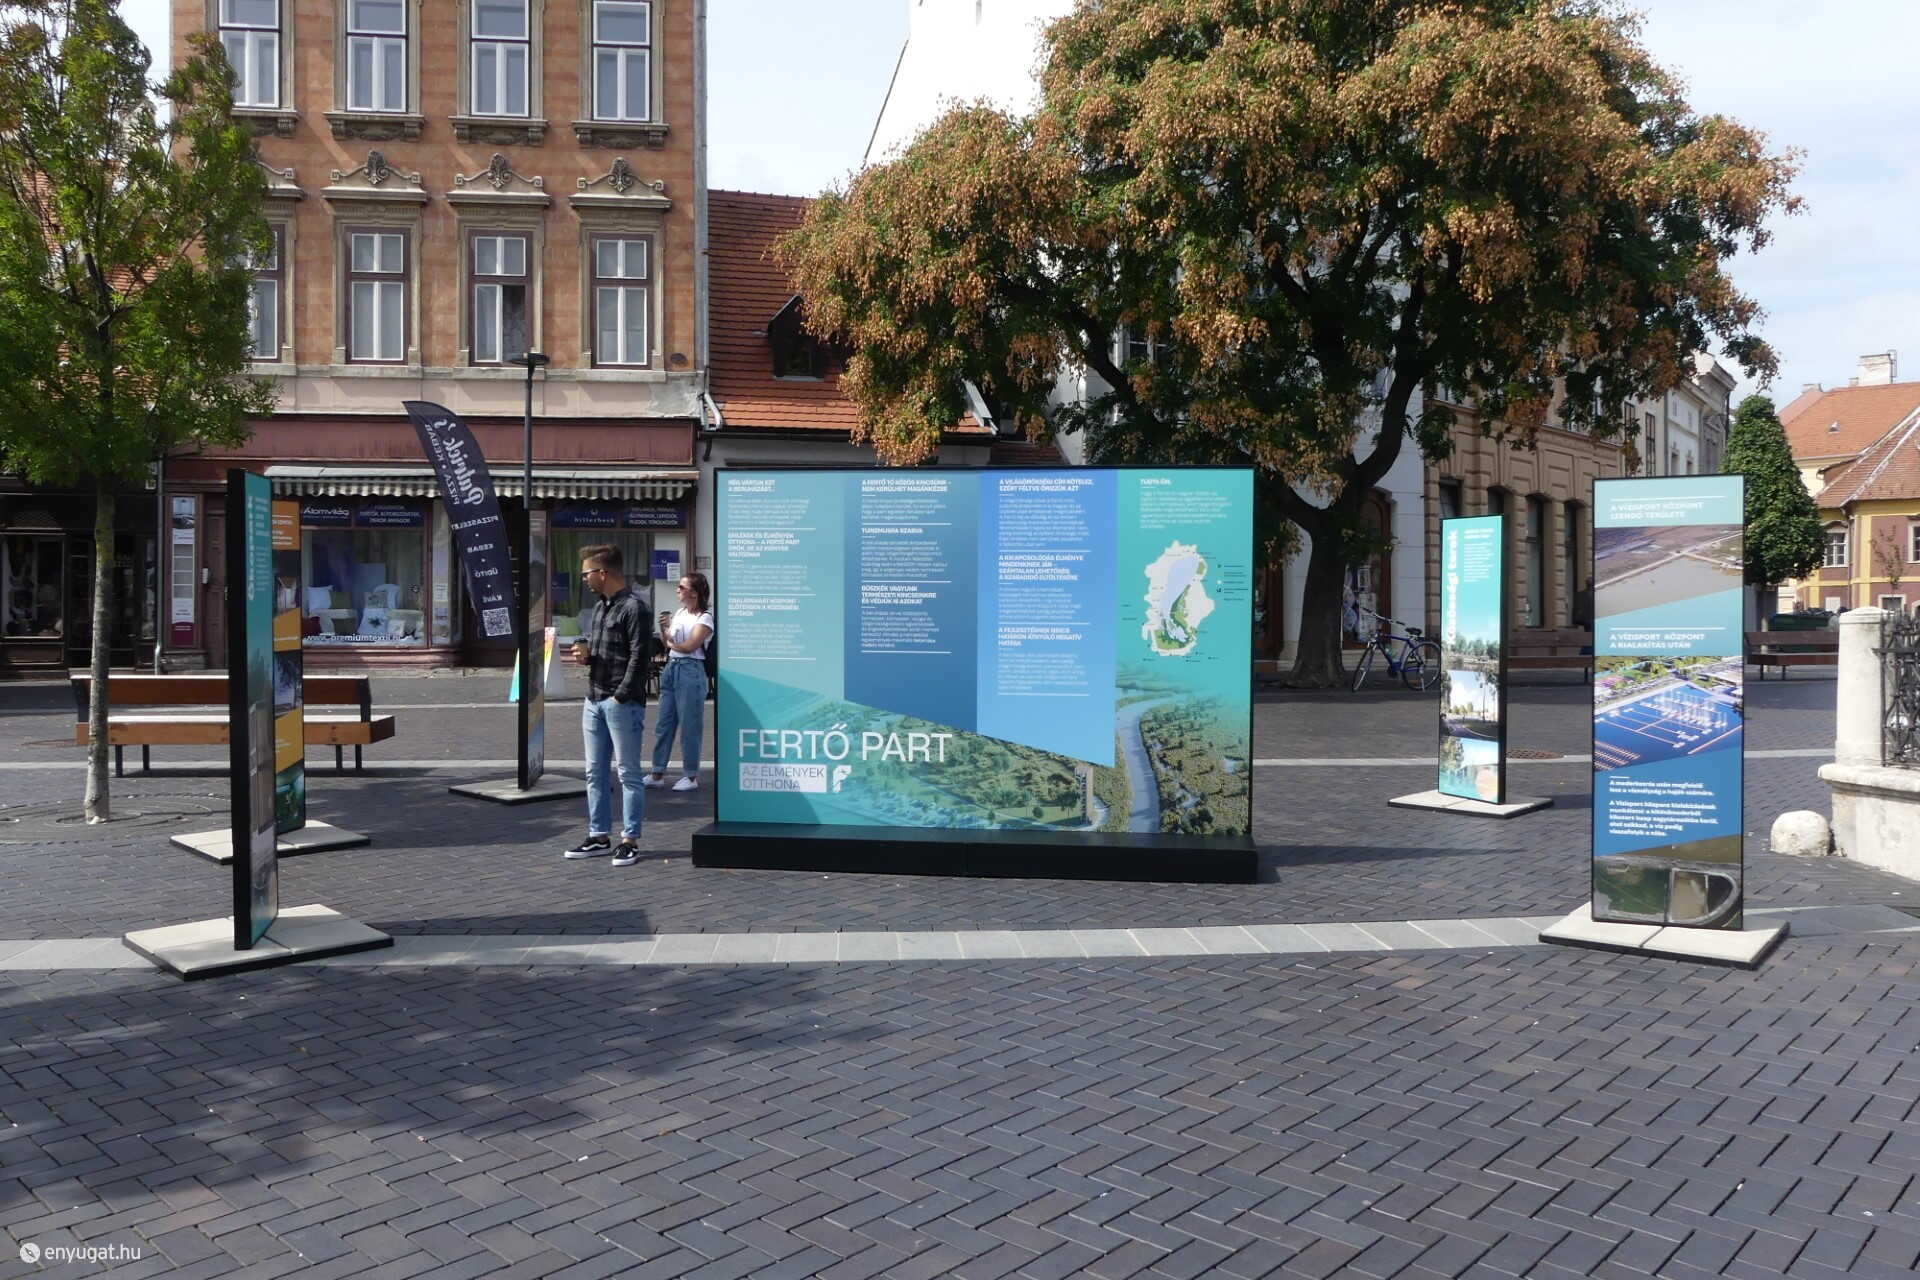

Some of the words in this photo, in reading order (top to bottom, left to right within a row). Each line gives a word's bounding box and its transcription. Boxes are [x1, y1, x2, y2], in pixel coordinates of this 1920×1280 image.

[739, 723, 850, 761] FERTŐ
[862, 731, 953, 763] PART
[742, 766, 760, 776] AZ
[761, 765, 825, 778] ÉLMÉNYEK
[742, 778, 800, 789] OTTHONA
